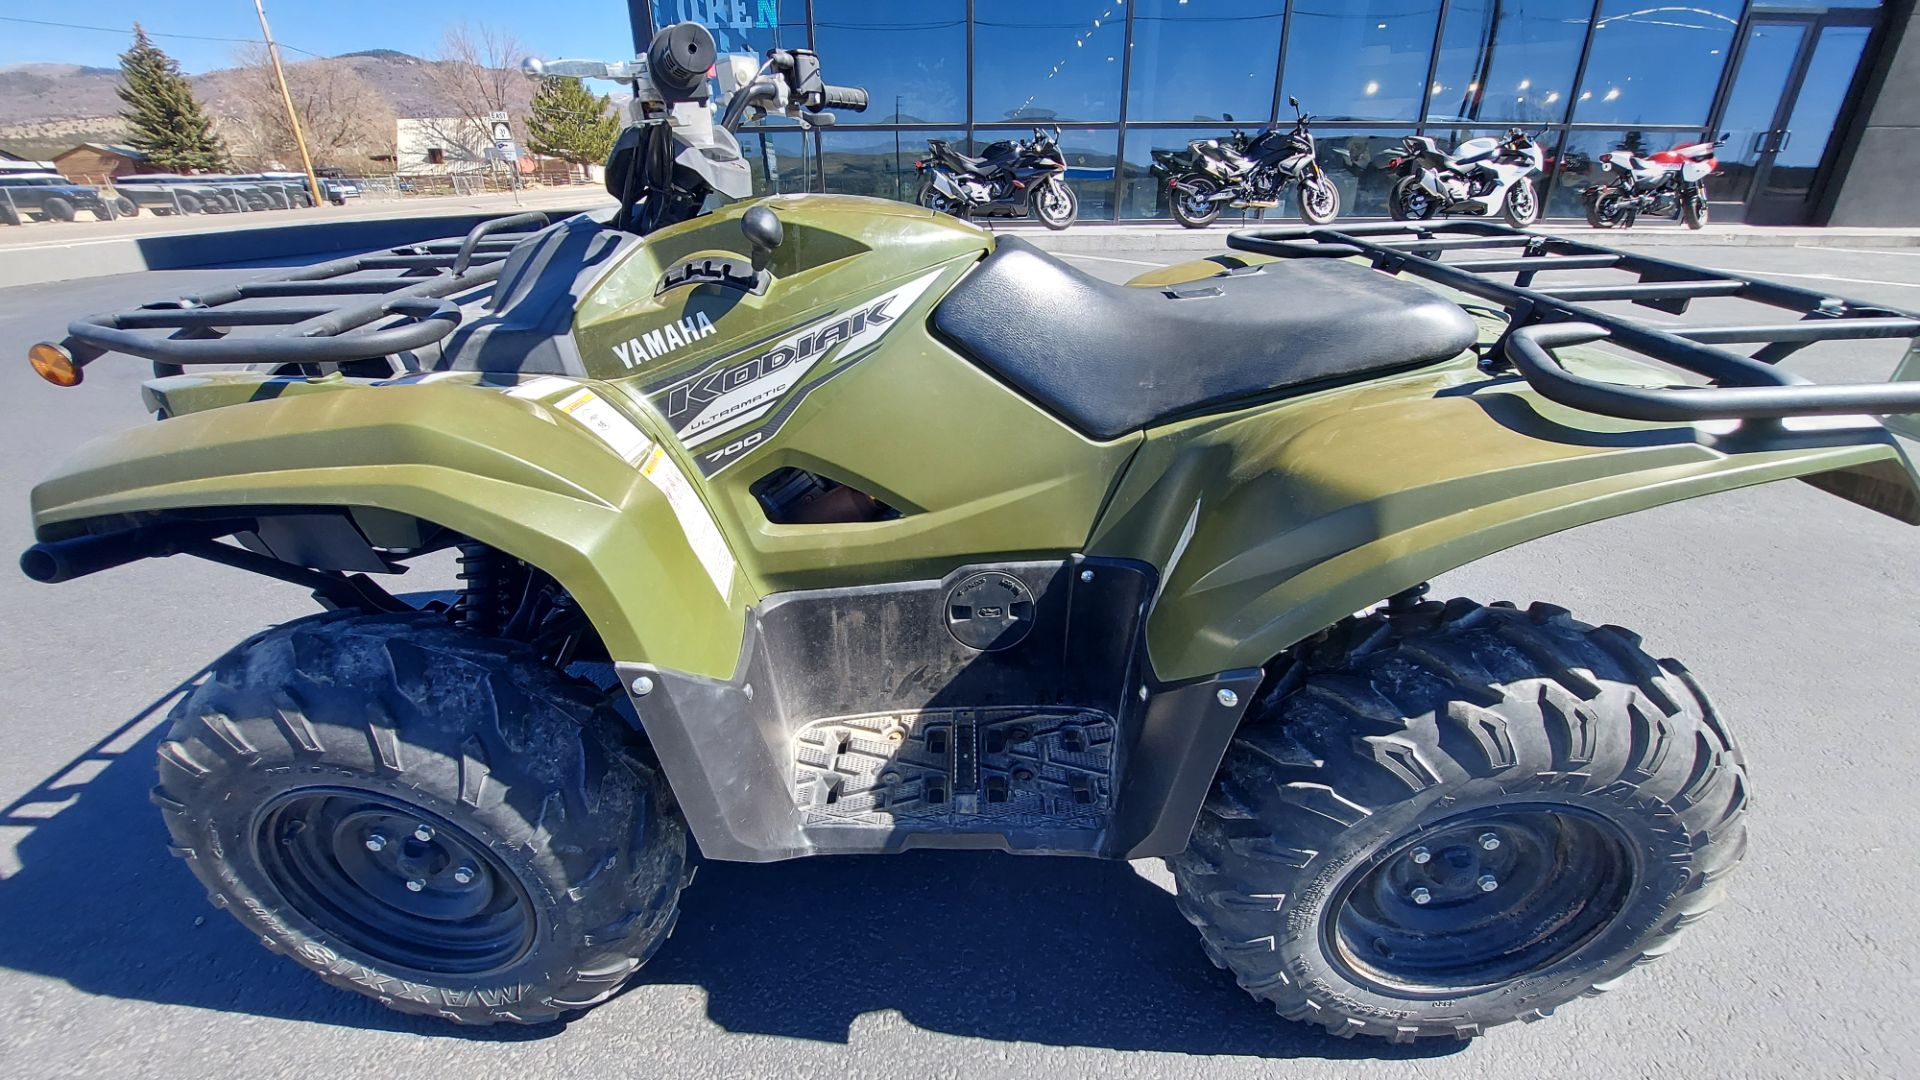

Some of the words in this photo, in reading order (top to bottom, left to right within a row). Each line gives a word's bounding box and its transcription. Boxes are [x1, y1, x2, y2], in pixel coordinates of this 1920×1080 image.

[611, 310, 718, 370] YAMAHA
[667, 294, 899, 419] KODIAK
[690, 383, 787, 430] ULTRAMATIC
[705, 432, 763, 463] 700
[298, 940, 534, 1008] MAXXIS
